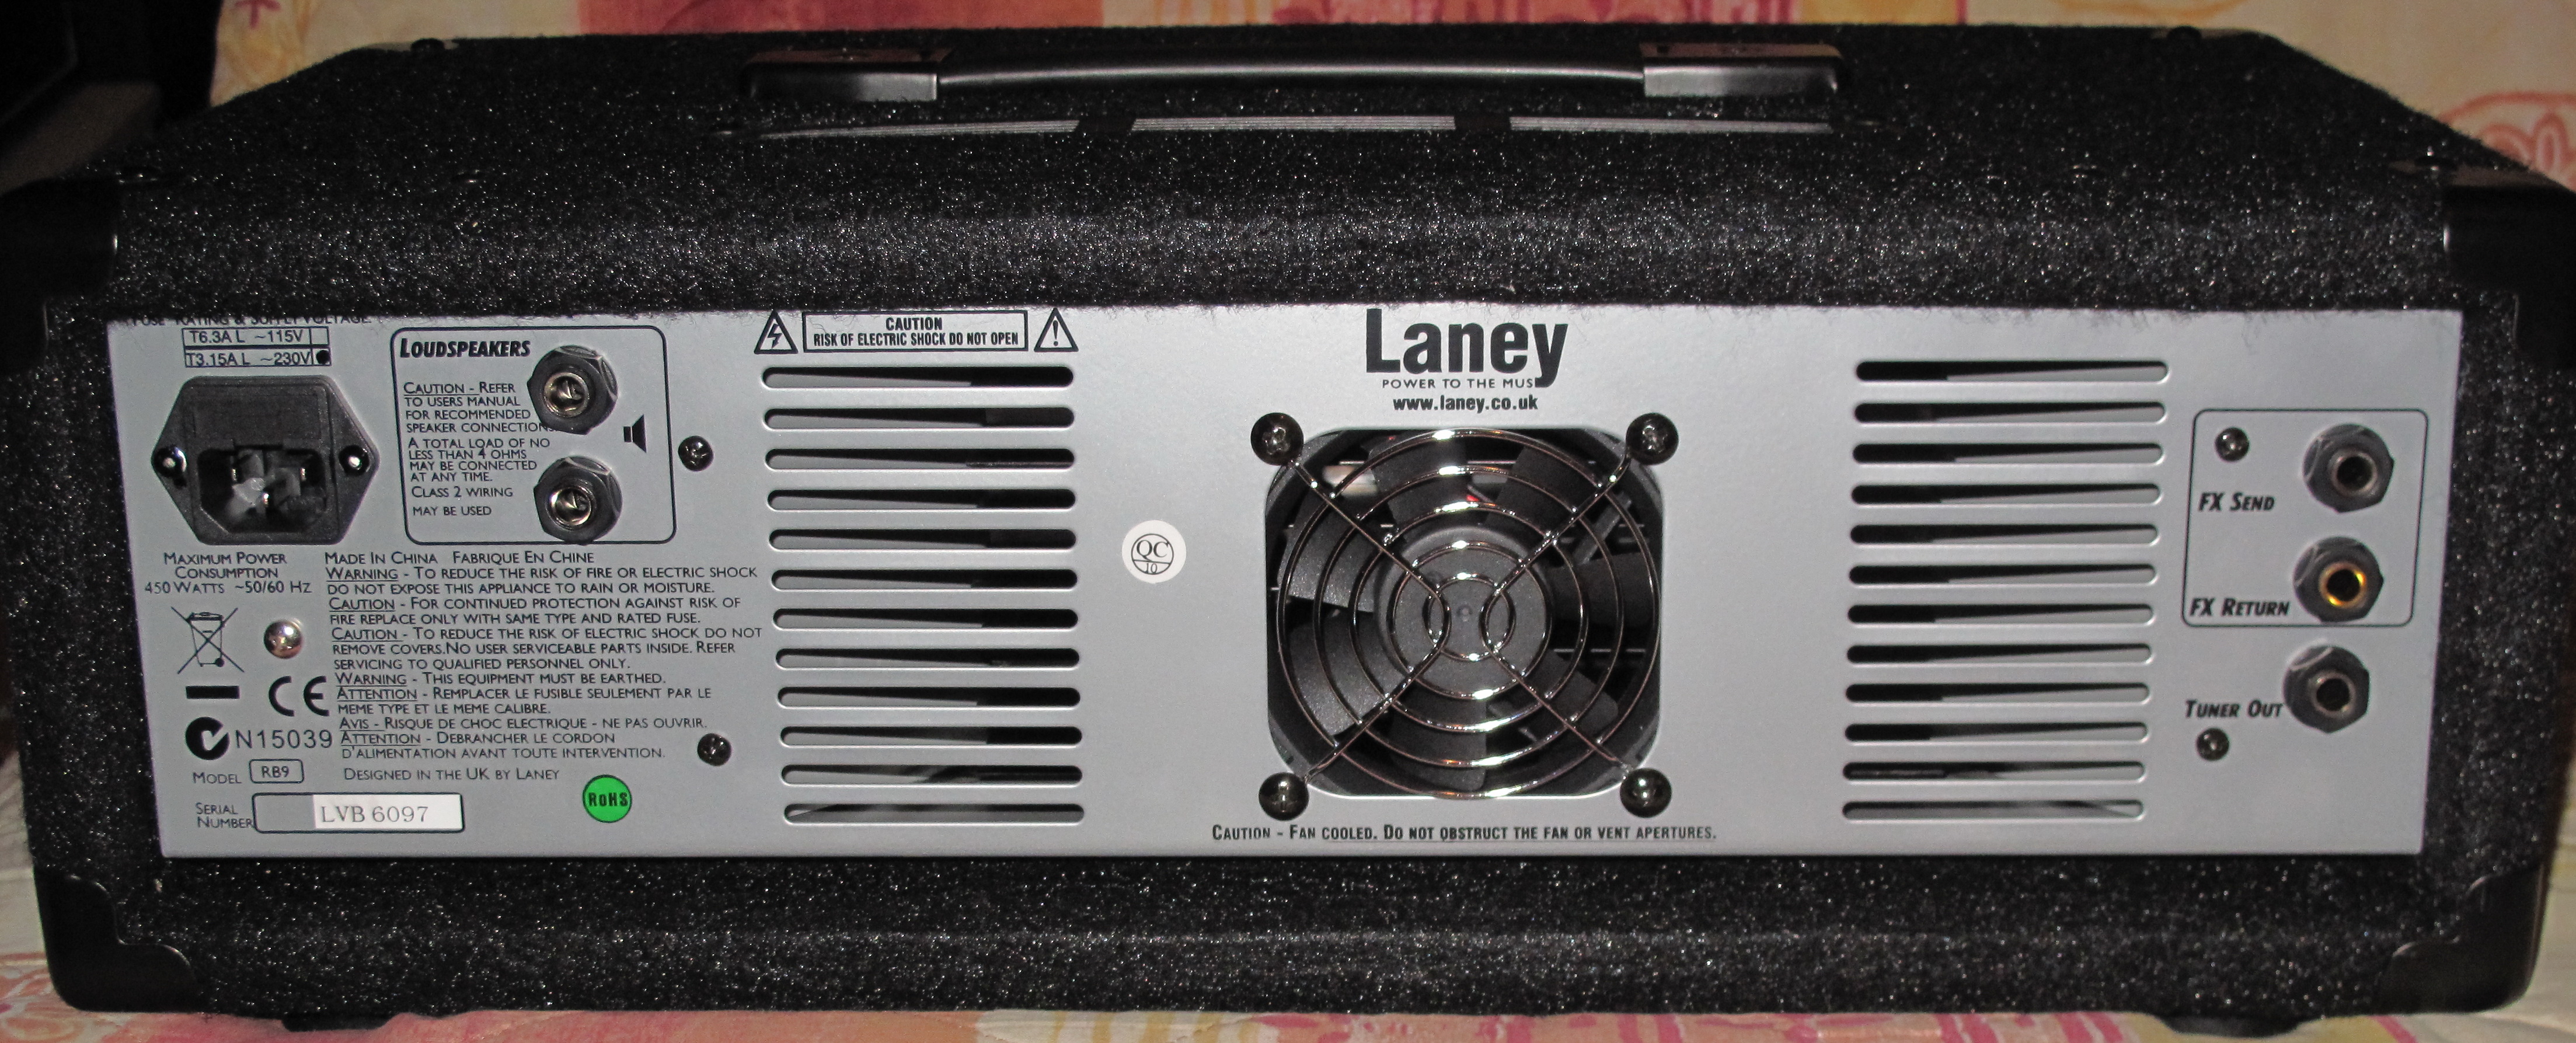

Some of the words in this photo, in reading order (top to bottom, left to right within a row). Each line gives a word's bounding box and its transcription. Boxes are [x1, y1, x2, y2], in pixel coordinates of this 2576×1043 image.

[886, 317, 942, 330] CAUTION
[190, 329, 232, 343] T6.3A
[236, 329, 245, 343] L
[814, 333, 837, 347] RISK
[841, 333, 853, 346] OF
[858, 333, 907, 346] ELECTRIC
[911, 332, 946, 346] SHOCK
[949, 332, 963, 345] DO
[967, 332, 987, 345] NOT
[991, 332, 1018, 344] OPEN
[400, 339, 530, 358] LOUDSPEAKERS
[1367, 309, 1568, 387] Laney
[186, 352, 237, 366] T3.15A
[242, 351, 250, 365] L
[403, 382, 464, 394] CAUTION
[479, 382, 515, 393] REFER
[1383, 379, 1435, 389] POWER
[1442, 379, 1460, 388] TO
[1467, 378, 1495, 388] THE
[405, 397, 423, 407] TO
[428, 397, 462, 406] USERS
[468, 396, 520, 406] MANUAL
[1393, 395, 1538, 413] www.laney.co.uk
[406, 410, 430, 420] FOR
[435, 410, 530, 420] RECOMMENDED
[406, 424, 456, 434] SPEAKER
[423, 439, 465, 448] TOTAL
[469, 438, 503, 448] LOAD
[508, 438, 525, 448] OF
[530, 438, 550, 448] NO
[409, 450, 433, 460] LESS
[438, 450, 473, 459] THAN
[478, 448, 486, 460] 4
[491, 449, 527, 459] OHMS
[410, 462, 434, 471] MAY
[440, 461, 454, 471] BE
[459, 461, 537, 470] CONNECTED
[411, 473, 426, 482] AT
[432, 472, 456, 482] ANY
[462, 472, 492, 482] TIME.
[412, 486, 449, 497] CLASS
[454, 486, 461, 497] 2
[466, 487, 513, 497] WIRING
[2199, 492, 2224, 511] FX
[2230, 493, 2274, 511] SEND
[1137, 540, 1168, 561] QC
[164, 552, 231, 564] MAXIMUM
[237, 552, 287, 564] POWER
[325, 552, 365, 564] MADE
[371, 552, 385, 564] IN
[391, 552, 438, 564] CHINA
[453, 551, 519, 563] FABRIQUE
[525, 551, 543, 563] EN
[550, 551, 594, 563] CHINE
[175, 567, 278, 578] CONSUMPTION
[326, 567, 398, 579] WARNING
[414, 567, 435, 579] TO
[442, 567, 494, 578] REDUCE
[499, 567, 525, 578] THE
[531, 567, 557, 578] RISK
[564, 567, 581, 578] OF
[587, 567, 612, 578] FIRE
[618, 567, 637, 578] OR
[643, 567, 705, 578] ELECTRIC
[710, 567, 757, 578] SHOCK
[145, 582, 170, 594] 450
[174, 582, 224, 594] WATTS
[327, 583, 348, 594] DO
[355, 583, 385, 594] NOT
[391, 583, 440, 594] EXPOSE
[445, 583, 473, 594] THIS
[479, 583, 550, 594] APPLIANCE
[555, 582, 575, 594] TO
[581, 582, 612, 594] RAIN
[619, 582, 639, 593] OR
[644, 582, 714, 593] MOISTURE.
[329, 598, 395, 609] CAUTION
[411, 598, 438, 609] FOR
[444, 598, 527, 609] CONTINUED
[533, 598, 619, 609] PROTECTION
[626, 598, 684, 608] AGAINST
[690, 598, 717, 608] RISK
[723, 598, 740, 608] OF
[2190, 598, 2215, 616] FX
[2222, 599, 2289, 616] RETURN
[330, 613, 355, 625] FIRE
[361, 613, 416, 625] REPLACE
[421, 613, 458, 625] ONLY
[463, 613, 500, 625] WITH
[506, 613, 540, 624] SAME
[545, 613, 576, 624] TYPE
[581, 613, 612, 624] AND
[618, 613, 661, 624] RATED
[667, 613, 700, 624] FUSE.
[333, 643, 385, 654] REMOVE
[476, 643, 508, 654] USER
[513, 643, 596, 654] SERVICEABLE
[601, 643, 641, 654] PARTS
[647, 642, 692, 653] INSIDE.
[697, 642, 735, 653] REFER
[336, 674, 406, 685] WARNING
[425, 673, 452, 684] THIS
[459, 673, 534, 684] EQUIPMENT
[540, 673, 575, 684] MUST
[581, 672, 595, 683] BE
[601, 672, 665, 683] EARTHED.
[337, 688, 417, 700] ATTENTION
[433, 688, 510, 699] REMPLACER
[515, 688, 529, 699] LE
[534, 688, 582, 699] FUSIBLE
[588, 688, 661, 699] SEULEMENT
[668, 688, 692, 698] PAR
[698, 688, 710, 698] LE
[2186, 700, 2240, 718] TUNER
[2247, 700, 2282, 718] OUT
[236, 729, 332, 748] N15039
[262, 766, 289, 777] RB9
[344, 768, 411, 780] DESIGNED
[417, 768, 430, 780] IN
[435, 768, 461, 780] THE
[466, 769, 489, 780] UK
[496, 769, 510, 780] BY
[517, 769, 559, 780] LANEY
[193, 772, 242, 784] MODEL
[196, 804, 238, 815] SERIAL
[322, 805, 365, 822] LVB
[372, 804, 428, 822] 6097
[197, 818, 255, 828] NUMBER
[1212, 824, 1270, 840] CAUTION
[1290, 824, 1315, 840] FAN
[1322, 825, 1376, 840] COOLED.
[1384, 825, 1403, 840] DO
[1409, 825, 1434, 840] NOT
[1441, 825, 1507, 840] OBSTRUCT
[1514, 825, 1537, 840] THE
[1545, 825, 1568, 840] FAN
[1575, 825, 1591, 840] OR
[1598, 825, 1630, 839] VENT
[1637, 825, 1716, 839] APERTURES.
